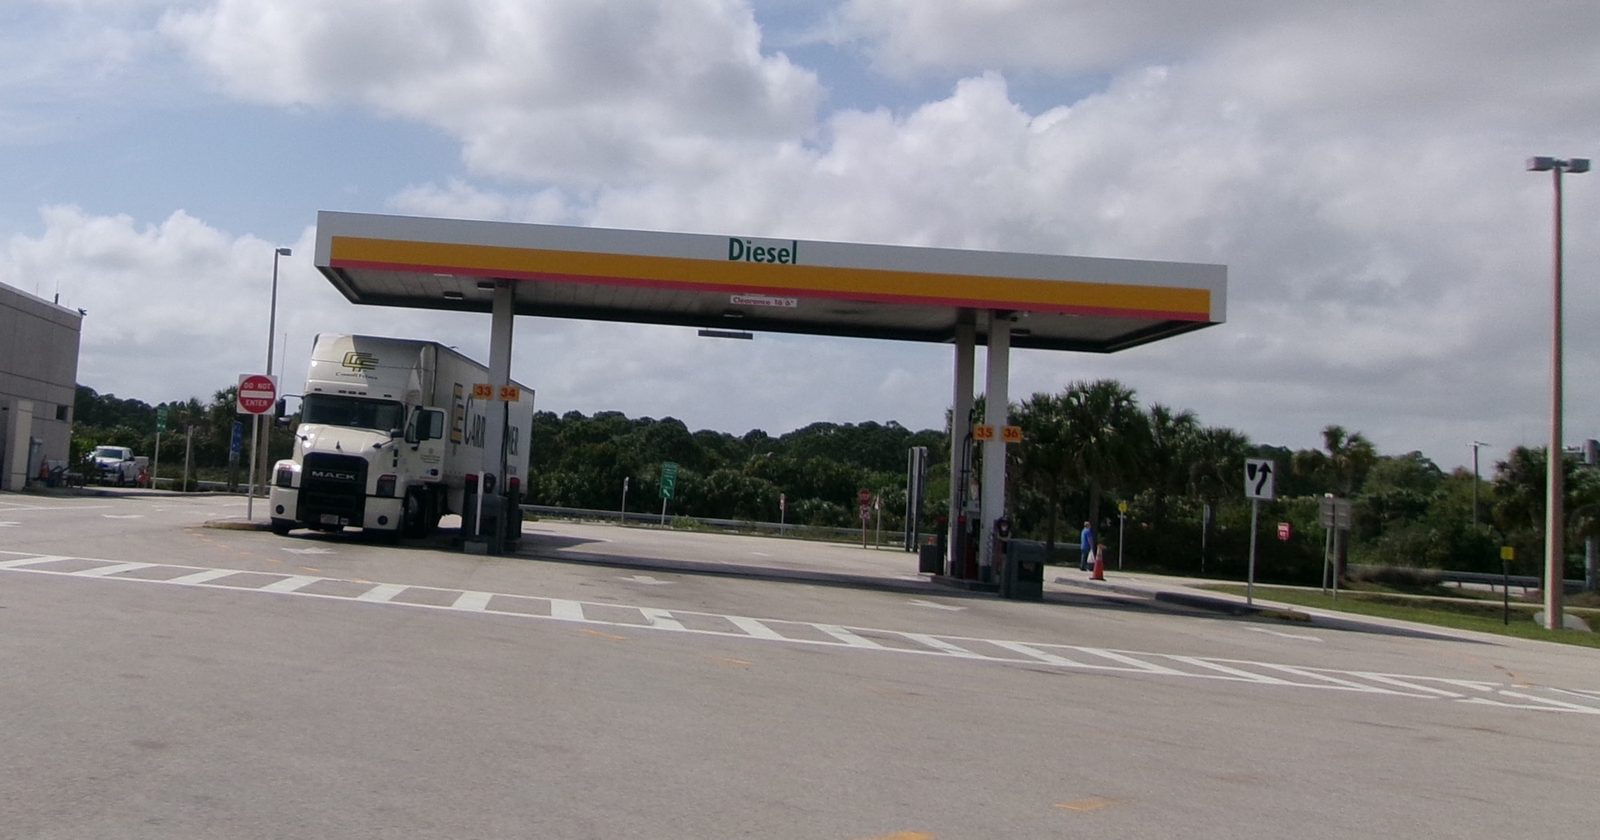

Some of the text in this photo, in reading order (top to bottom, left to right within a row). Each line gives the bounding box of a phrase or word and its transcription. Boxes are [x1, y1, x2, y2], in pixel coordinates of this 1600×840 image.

[729, 238, 797, 264] Diesel
[476, 386, 492, 396] 33
[500, 387, 516, 397] 34
[976, 427, 993, 438] 35
[1004, 427, 1019, 438] 36
[312, 471, 356, 480] MACK
